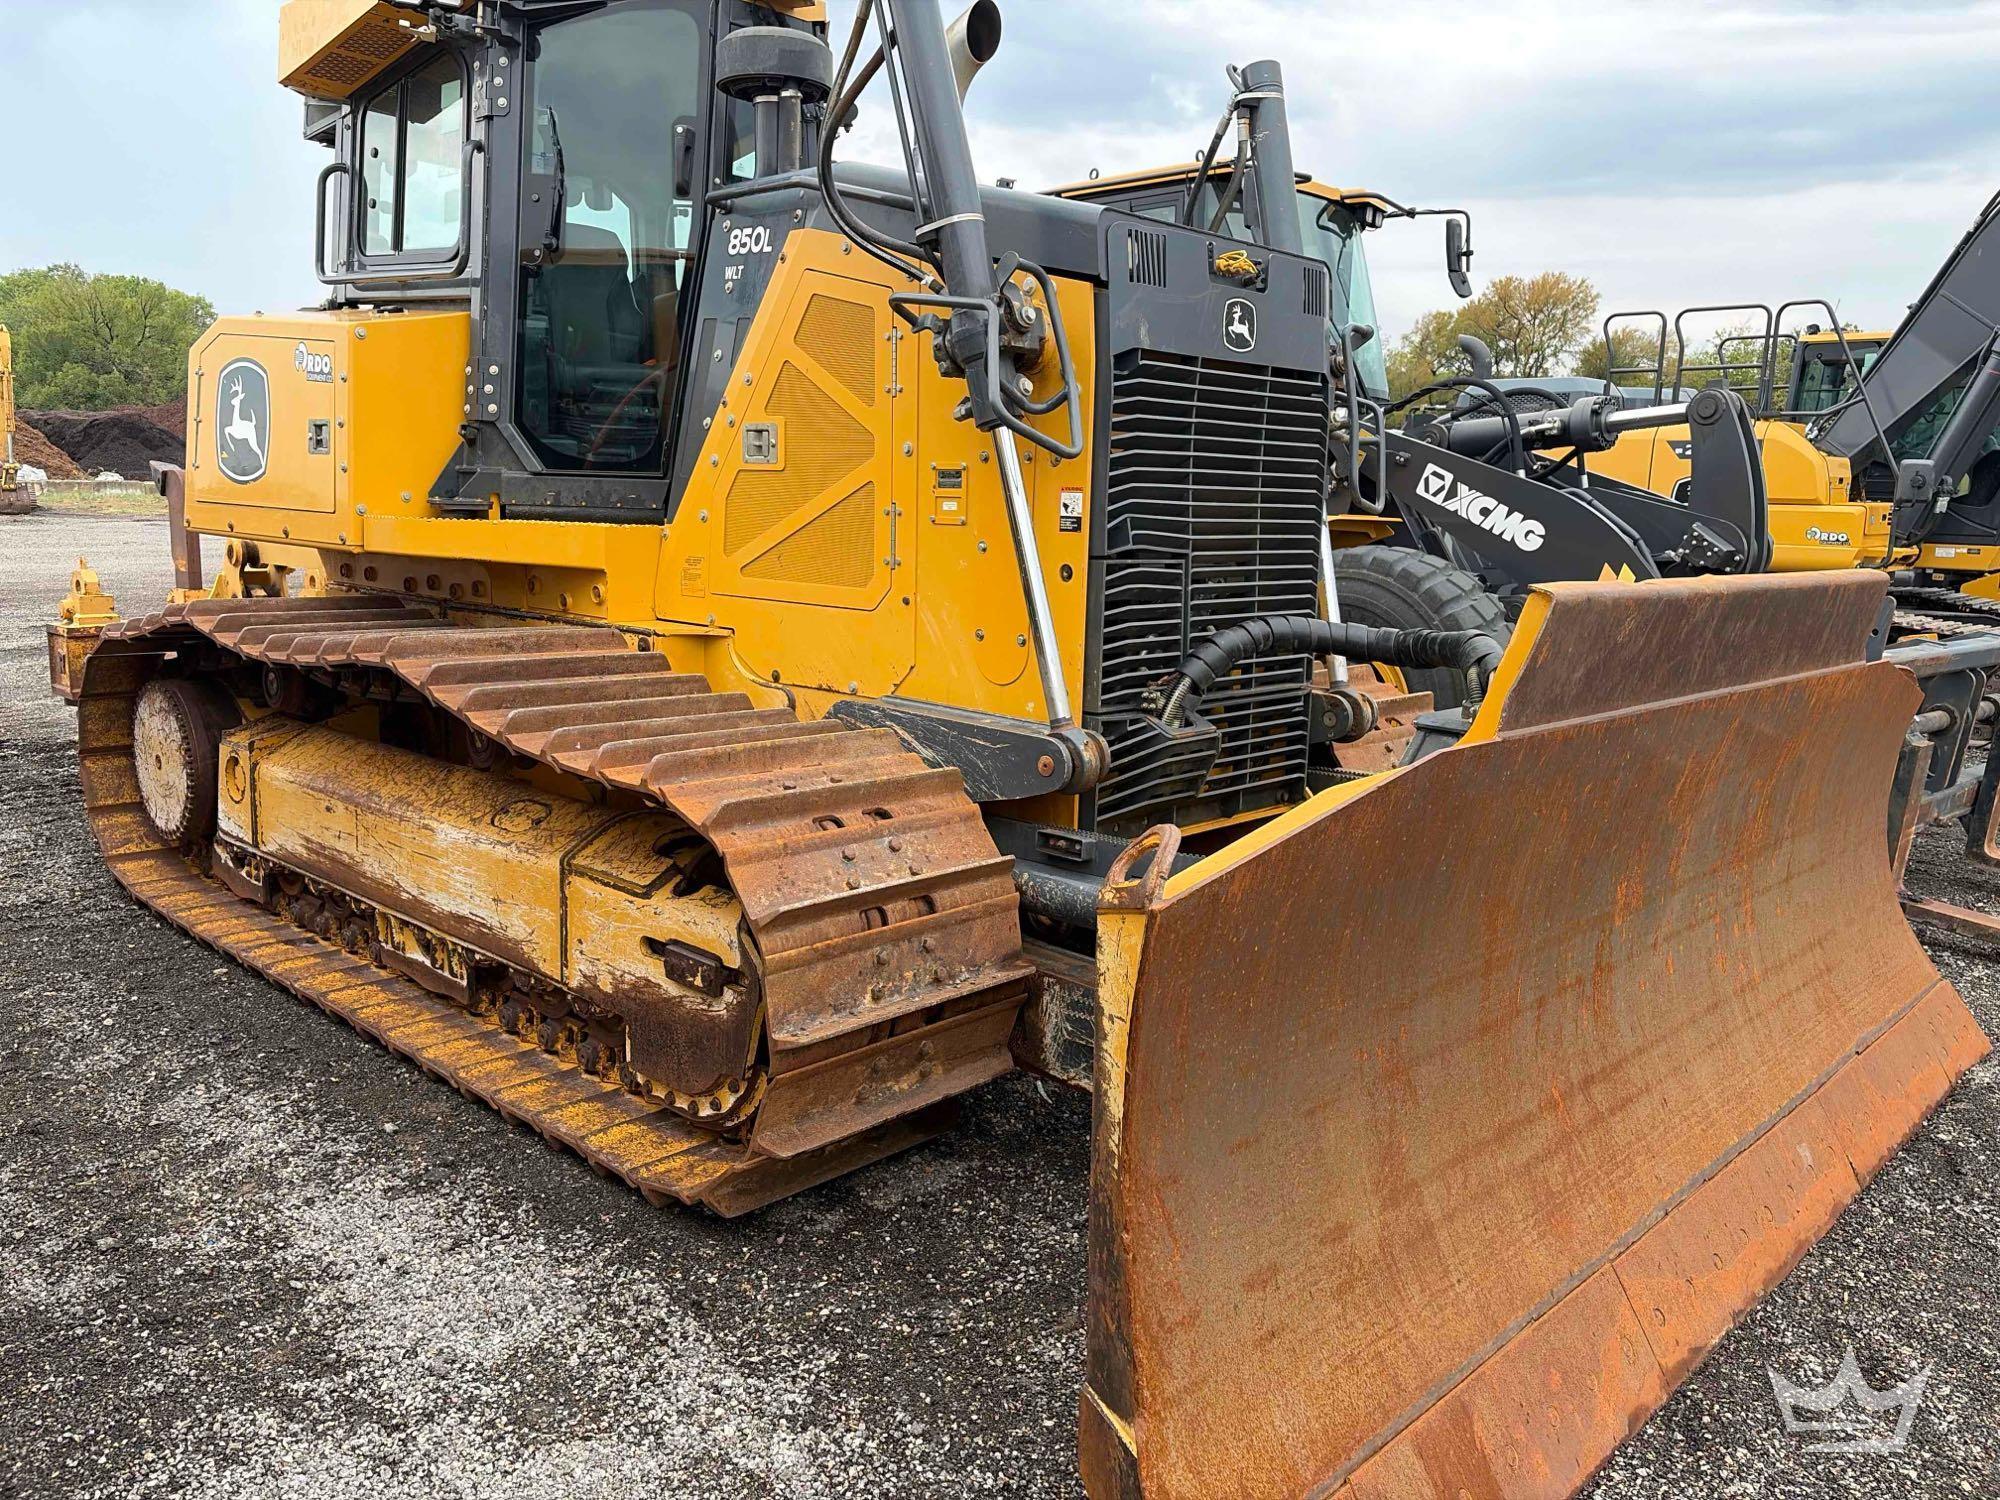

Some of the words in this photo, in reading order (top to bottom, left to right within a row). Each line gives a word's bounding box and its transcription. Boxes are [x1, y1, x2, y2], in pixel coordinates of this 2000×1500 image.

[728, 225, 773, 256] 850L
[725, 265, 745, 280] WLT
[307, 353, 331, 374] RDO
[1441, 481, 1546, 552] XCMG
[1820, 532, 1848, 542] RDO
